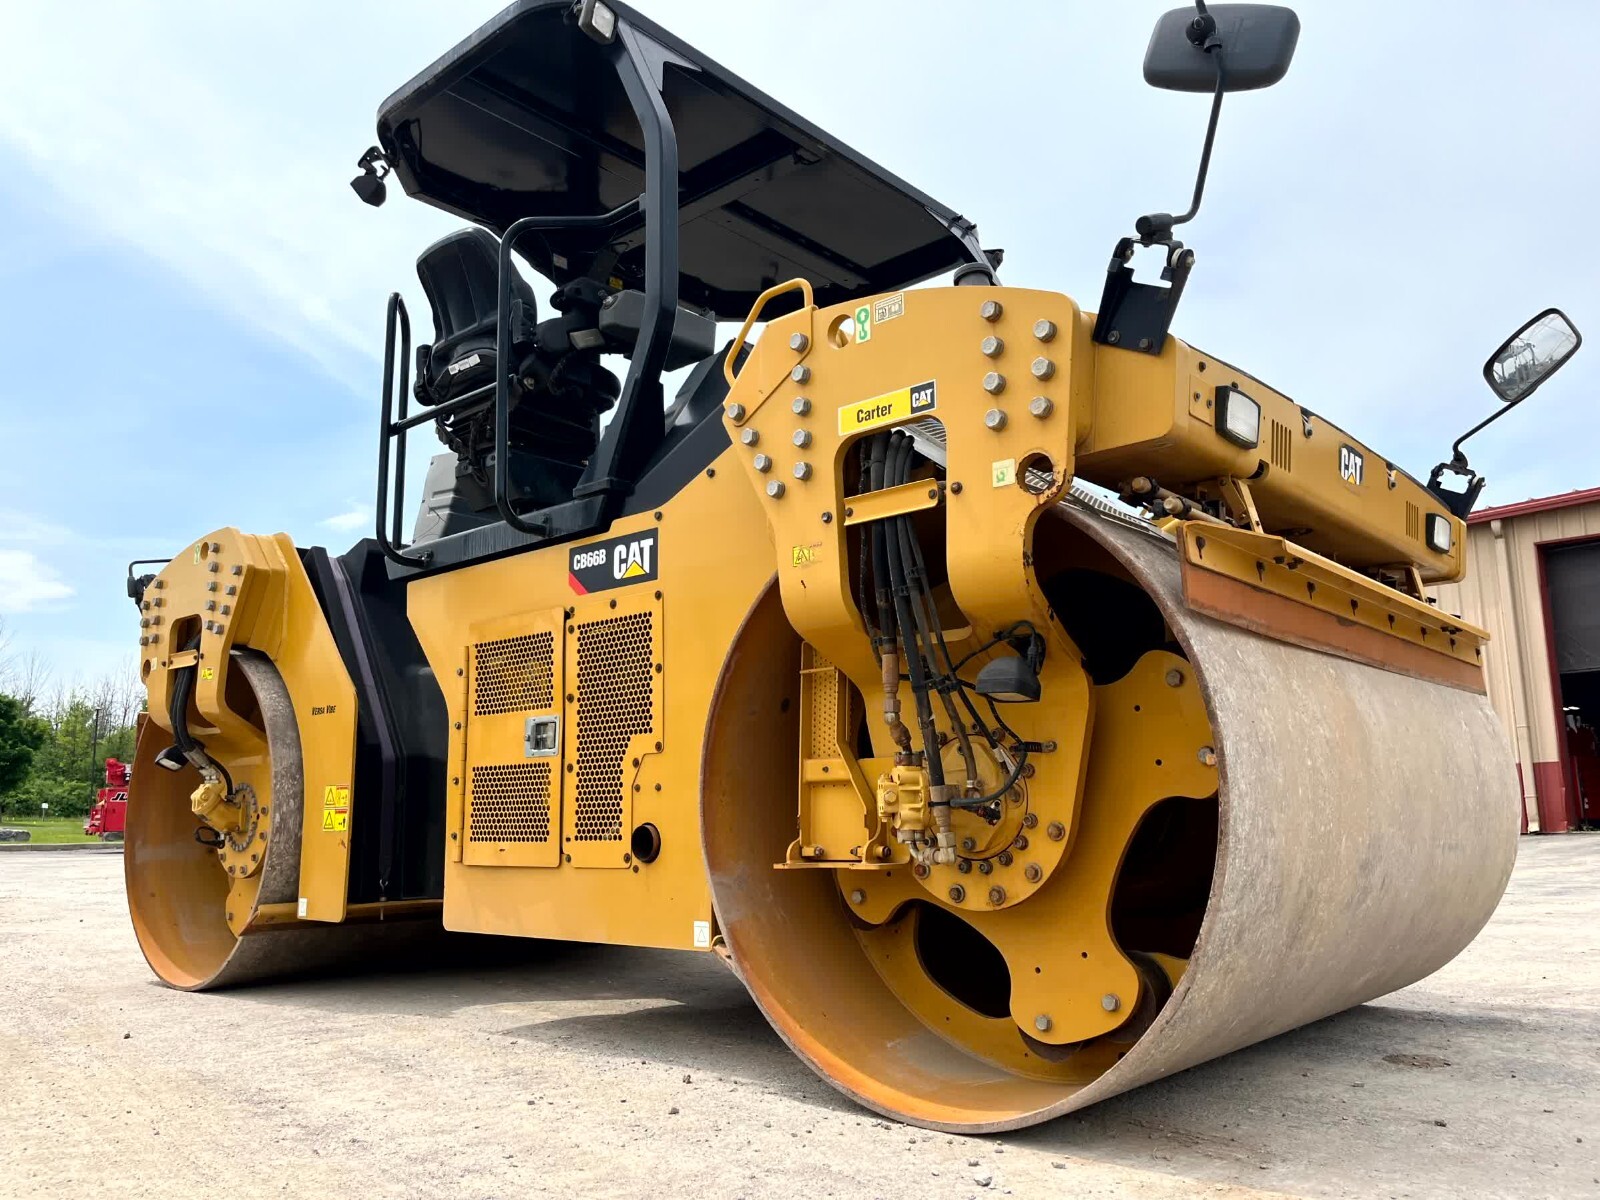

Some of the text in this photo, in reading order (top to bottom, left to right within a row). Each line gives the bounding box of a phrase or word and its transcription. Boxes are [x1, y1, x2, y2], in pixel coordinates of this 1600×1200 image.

[856, 388, 934, 424] Carter CAT
[1340, 447, 1362, 486] CAT
[573, 537, 654, 580] CB66B CAT
[111, 792, 127, 801] JL
